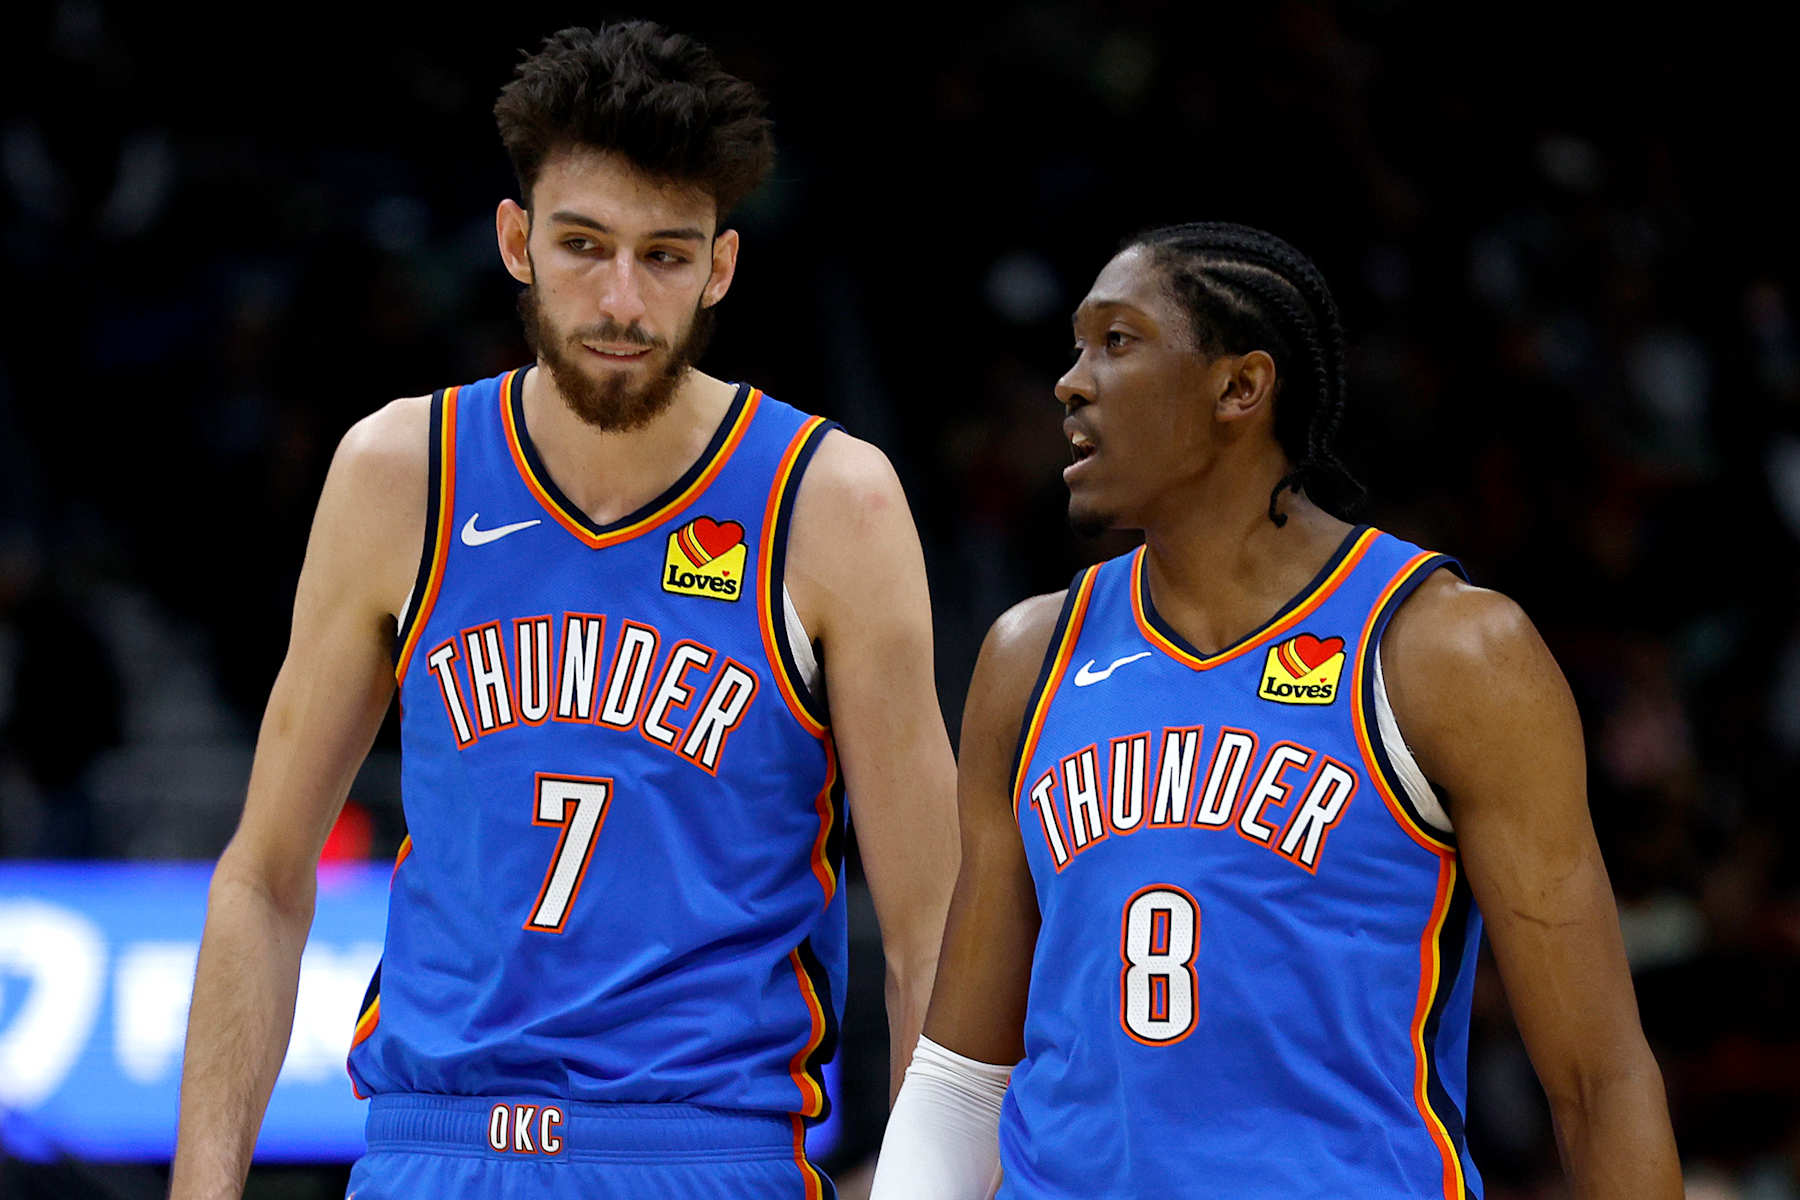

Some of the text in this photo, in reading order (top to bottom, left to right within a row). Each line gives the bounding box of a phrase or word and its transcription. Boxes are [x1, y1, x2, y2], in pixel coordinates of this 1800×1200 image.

[428, 612, 760, 777] THUNDER
[523, 772, 614, 934] 7
[1030, 725, 1359, 875] THUNDER
[1120, 883, 1200, 1047] 8
[488, 1102, 564, 1156] OKC
